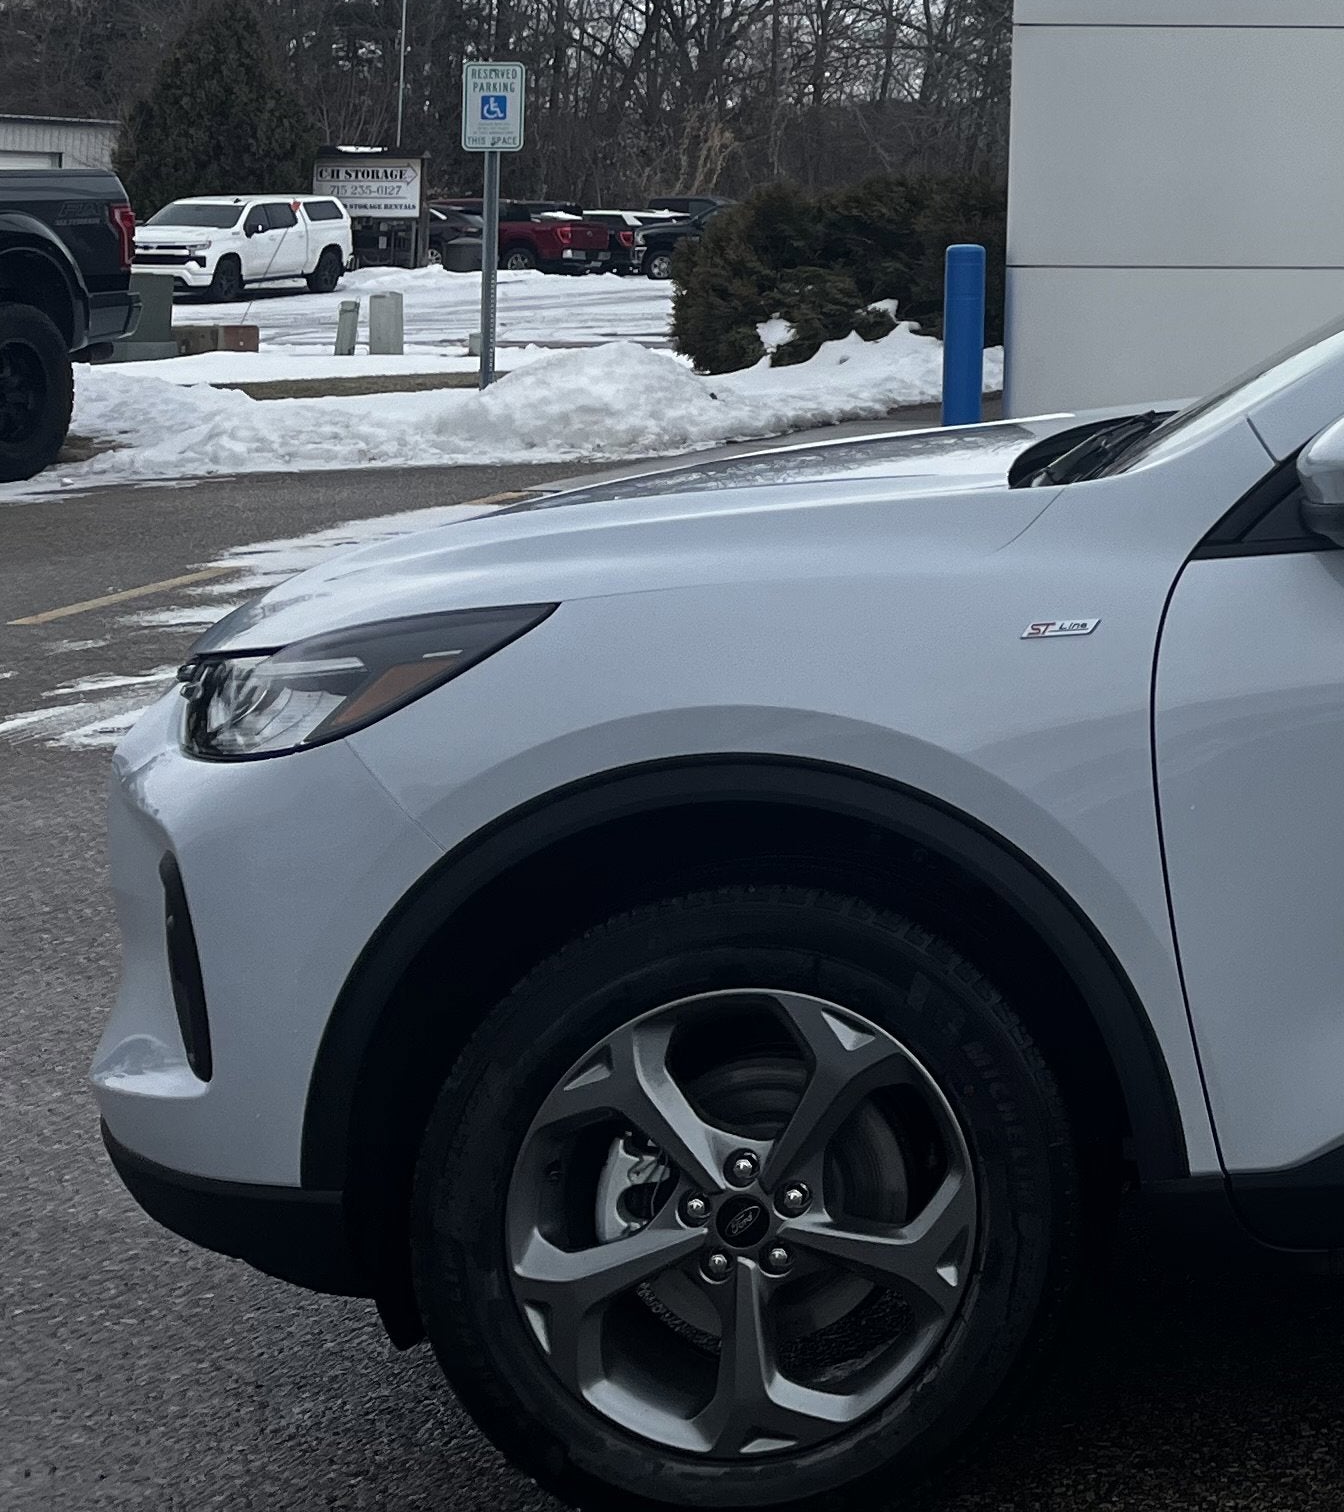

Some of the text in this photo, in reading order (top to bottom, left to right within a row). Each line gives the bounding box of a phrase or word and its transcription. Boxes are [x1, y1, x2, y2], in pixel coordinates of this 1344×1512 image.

[471, 68, 517, 79] RESERVED
[473, 82, 515, 93] PARKING
[467, 136, 517, 145] THIS SPACE
[344, 168, 407, 180] STORAGE
